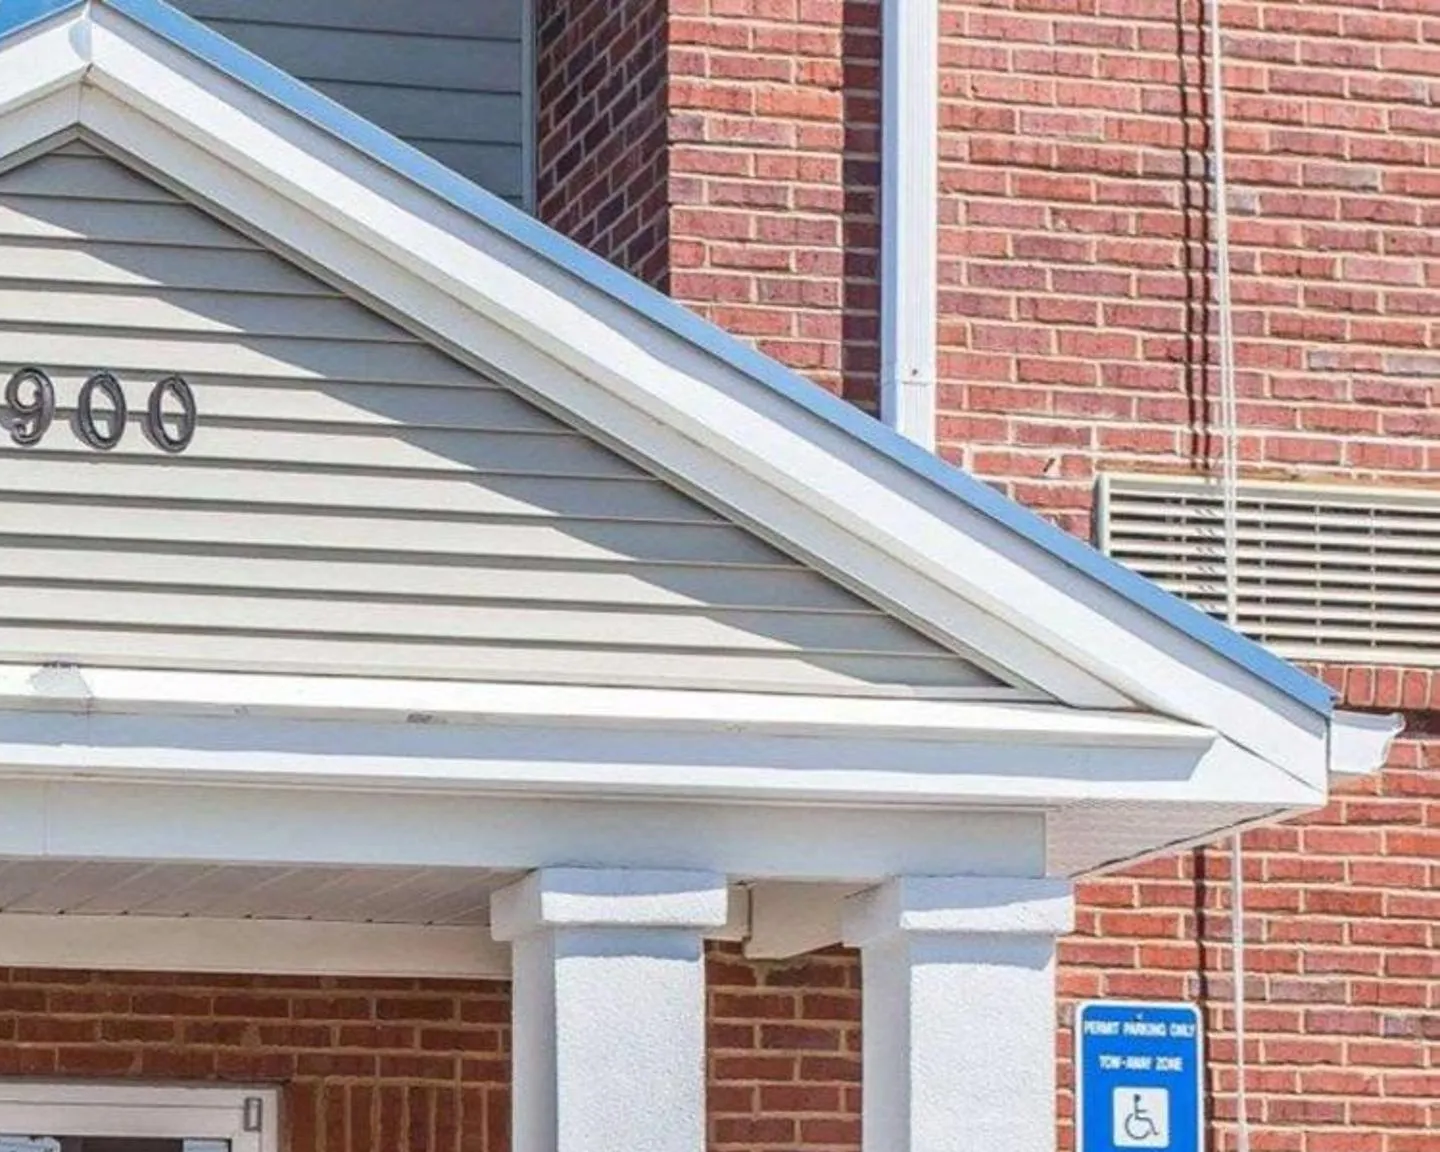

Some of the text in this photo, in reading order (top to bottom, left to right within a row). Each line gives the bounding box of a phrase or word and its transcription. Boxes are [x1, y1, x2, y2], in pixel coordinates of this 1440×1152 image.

[1084, 1020, 1195, 1038] PERMIT PARKING ONLY
[1155, 1055, 1183, 1072] ZONE
